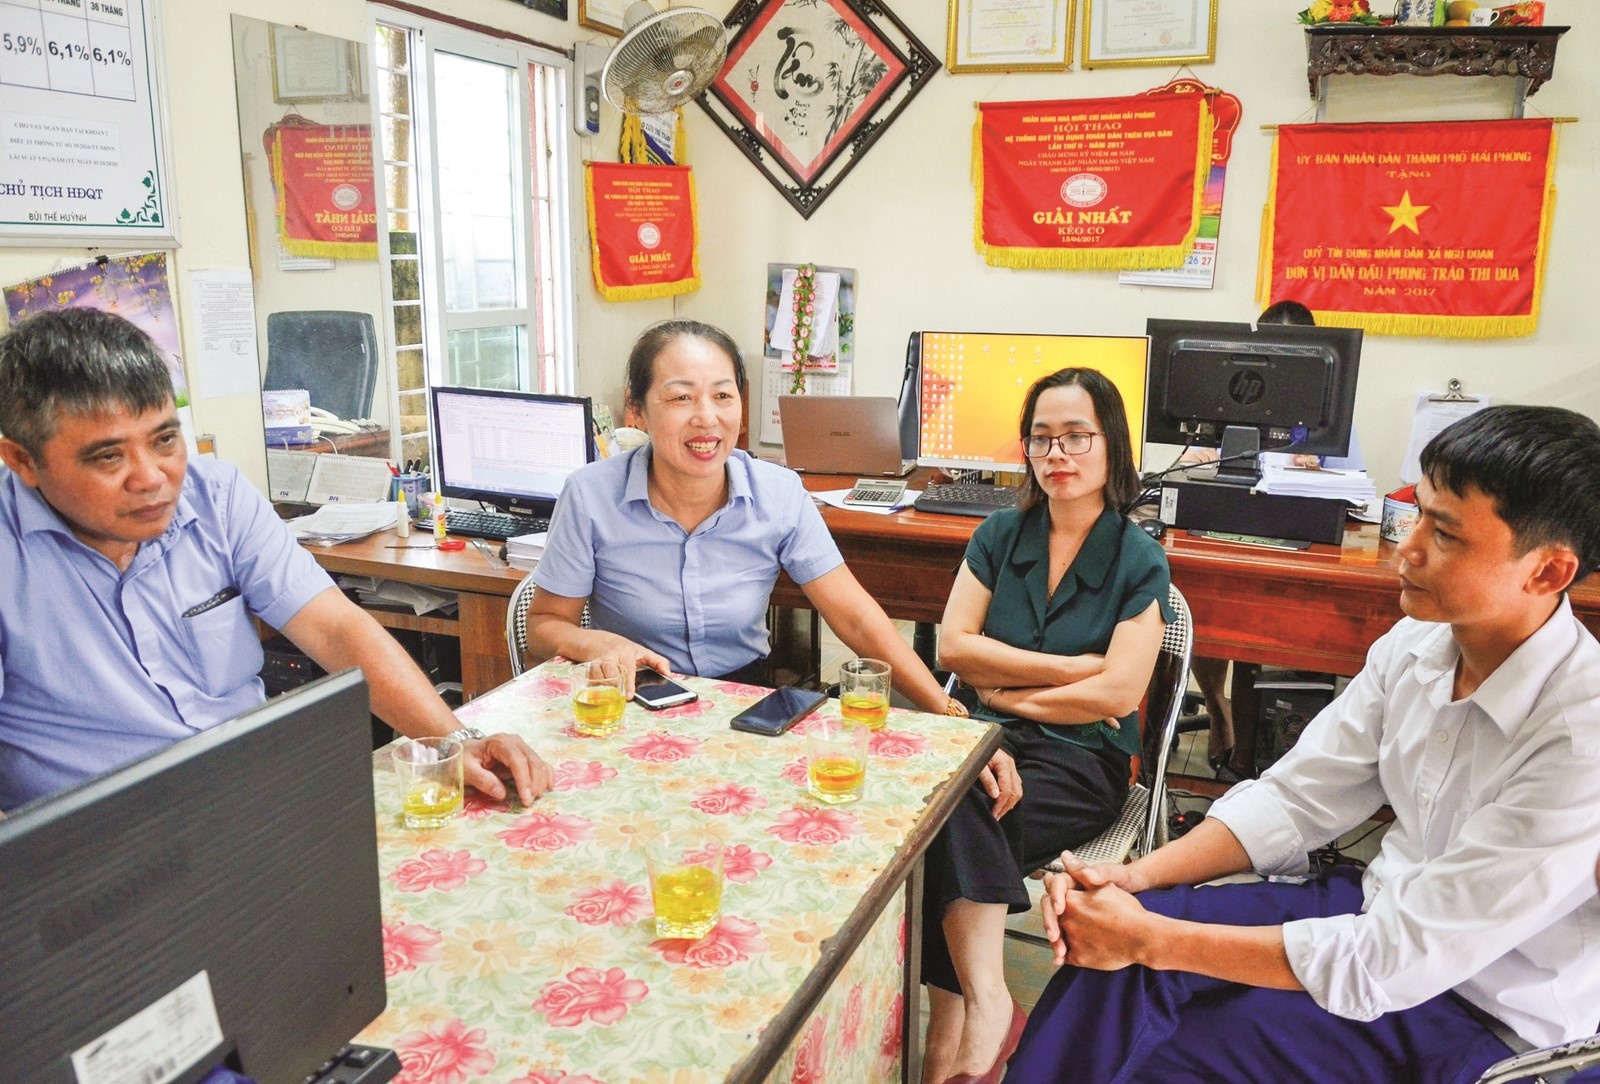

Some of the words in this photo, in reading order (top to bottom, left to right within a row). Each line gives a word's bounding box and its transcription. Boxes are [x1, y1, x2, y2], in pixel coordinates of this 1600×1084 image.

[90, 1, 100, 11] 36
[100, 3, 123, 17] THÁNG
[3, 33, 42, 56] 5,9%
[48, 41, 90, 61] 6,1%
[93, 47, 131, 66] 6,1%
[1054, 121, 1079, 133] HỘI
[1082, 122, 1122, 131] THAO
[1315, 154, 1340, 164] BAN
[1343, 152, 1375, 164] NHÂN
[1378, 152, 1401, 164] DÂN
[1405, 151, 1440, 164] THÀNH
[0, 179, 26, 196] CHỦ
[30, 185, 64, 200] TỊCH
[67, 187, 104, 200] HĐQT
[44, 210, 58, 221] THẾ
[60, 211, 87, 222] HUỲNH
[1033, 206, 1074, 224] GIẢI
[1078, 206, 1133, 224] NHẤT
[1058, 225, 1084, 235] KÉO
[1087, 226, 1105, 235] CO
[1374, 246, 1401, 258] NHÂN
[1404, 246, 1424, 259] DÂN
[1188, 256, 1199, 265] 26
[1201, 256, 1212, 266] 27
[1313, 266, 1326, 282] VỊ
[1387, 266, 1426, 280] PHONG
[1431, 265, 1465, 281] TRÀO
[1469, 267, 1491, 281] THI
[1363, 285, 1396, 296] NĂM
[1403, 288, 1436, 296] 2017
